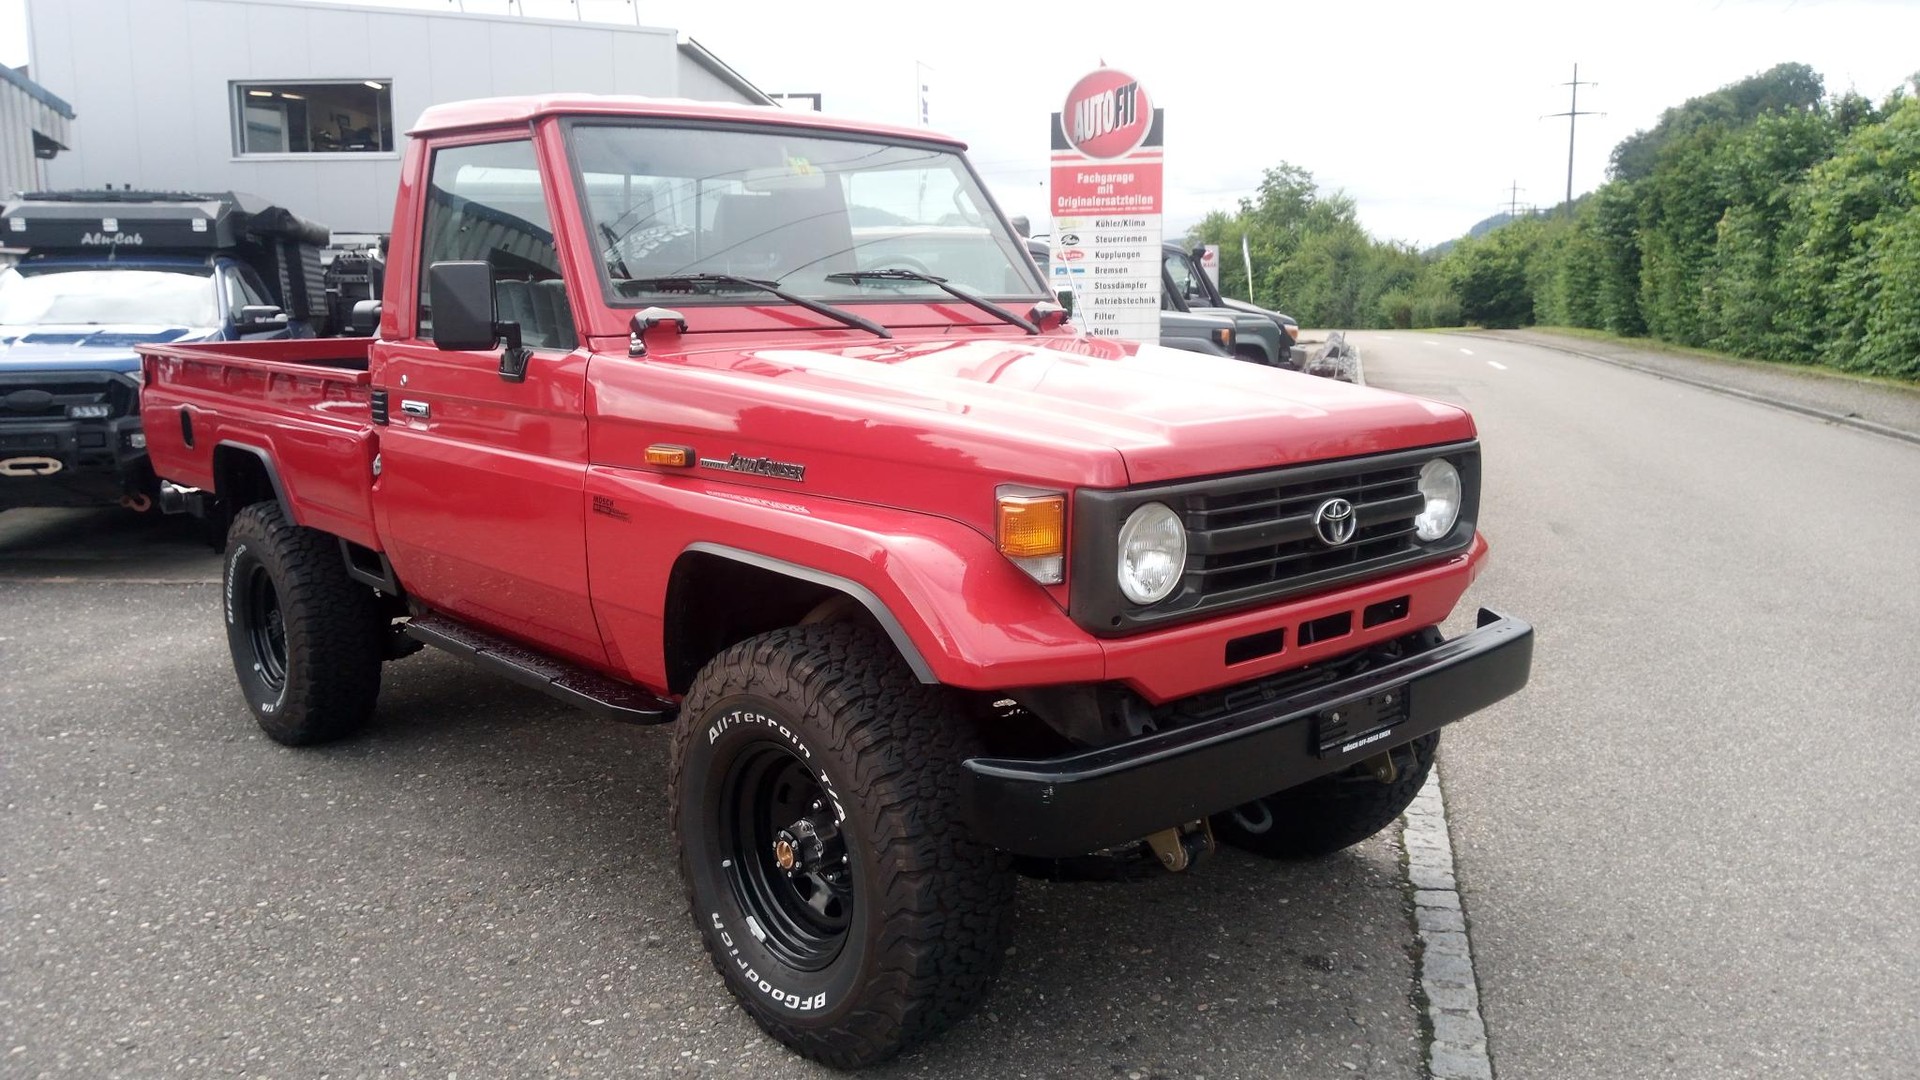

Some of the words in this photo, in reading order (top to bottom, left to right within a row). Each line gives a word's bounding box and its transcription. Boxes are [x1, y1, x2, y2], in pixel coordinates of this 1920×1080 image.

[1073, 80, 1140, 145] AUTOFIT
[1077, 172, 1134, 185] Fachgarage
[1097, 185, 1113, 194] mit
[1058, 195, 1153, 208] Originalersatzteilen
[1095, 218, 1146, 228] Kühler/Klima
[81, 232, 144, 246] Alu-Cab
[1095, 235, 1147, 244] Steuerriemen
[1095, 250, 1141, 260] Kupplungen
[1095, 266, 1128, 275] Bremsen
[1094, 281, 1148, 292] Stossdämpfer
[1094, 296, 1156, 306] Antriebstechnik
[1094, 312, 1116, 320] Filter
[1094, 327, 1119, 336] Reifen
[706, 709, 813, 760] All-Terrain
[818, 768, 847, 823] T/A
[711, 911, 828, 1011] BFGoodrich
